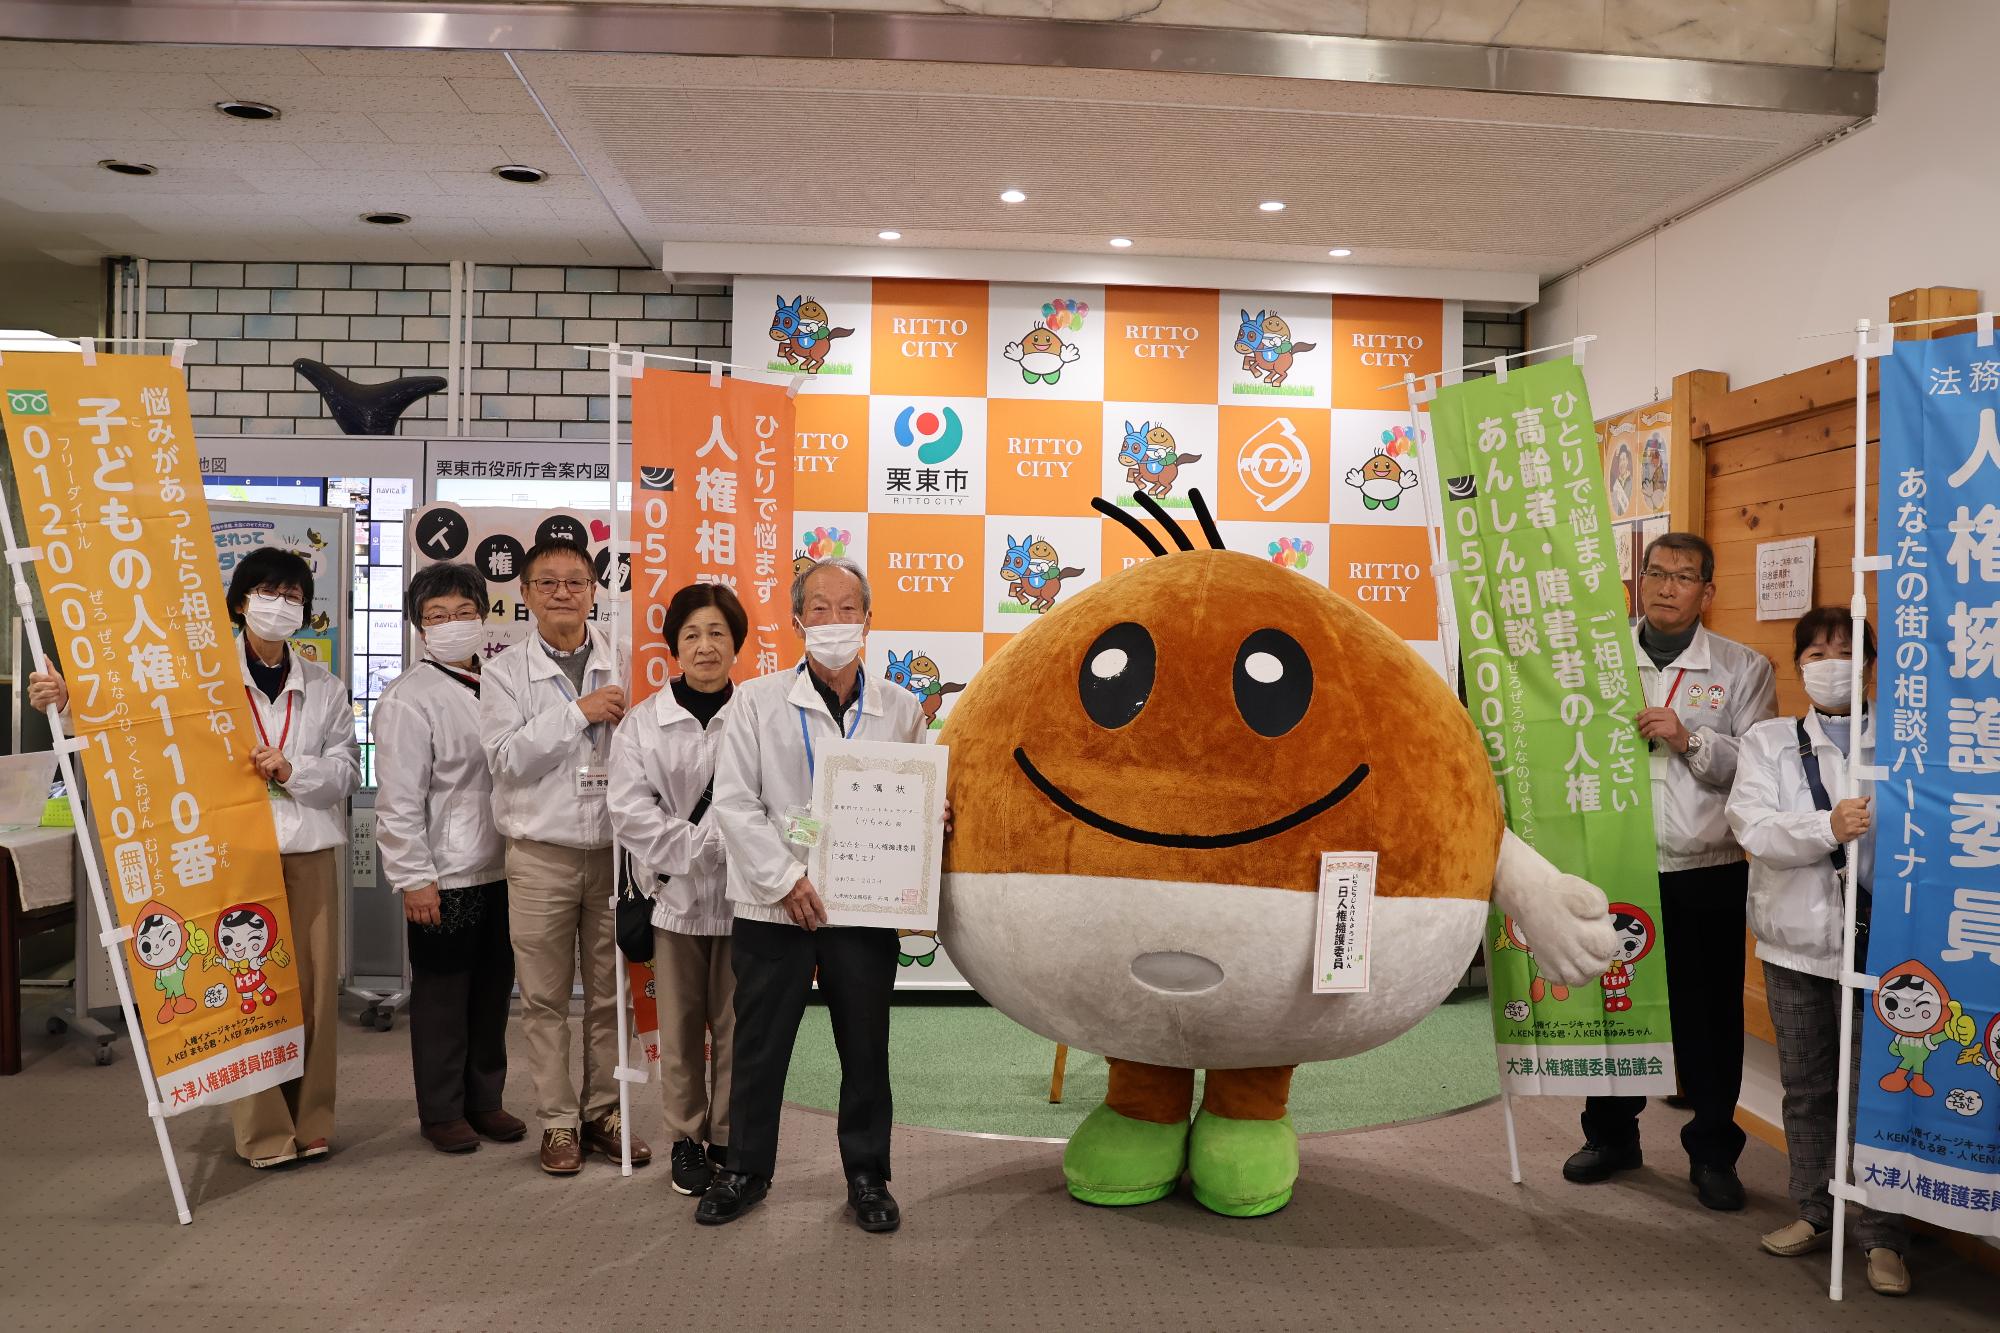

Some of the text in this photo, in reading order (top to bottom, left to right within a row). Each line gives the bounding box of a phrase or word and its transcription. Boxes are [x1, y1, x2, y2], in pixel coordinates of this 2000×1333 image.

[892, 317, 968, 337] RITTO
[1124, 324, 1199, 341] RITTO
[901, 340, 959, 358] CITY
[1134, 343, 1191, 359] CITY
[1351, 333, 1424, 350] RITTO
[1360, 352, 1415, 368] CITY
[795, 432, 849, 450] TTO
[1008, 437, 1082, 457] RITTO
[436, 460, 609, 479] 栗東市役所庁舎案内図
[1016, 460, 1074, 478] CITY
[886, 467, 968, 493] 栗東市
[57, 437, 92, 551] フリーダイヤル
[893, 497, 964, 506] RITTO CITY
[753, 414, 779, 605] ひとりで悩まず
[1478, 417, 1541, 657] あんしん相談
[488, 551, 513, 576] 権
[888, 552, 964, 571] RITTO
[1349, 562, 1420, 581] RITTO
[140, 387, 235, 763] 悩みがあったら相談してね！
[897, 575, 955, 594] CITY
[1357, 585, 1412, 603] CITY
[1551, 391, 1639, 812] ひとりで悩まず ご相談ください
[1511, 407, 1602, 813] 高齢者・障害者の人権
[78, 397, 217, 888] 子どもの人権110番
[1893, 467, 1928, 914] あなたの街の相談パートナー
[1506, 661, 1536, 845] ぜろぜろみんなのひゃくと
[119, 848, 148, 898] 無料
[1333, 878, 1350, 970] 一日人権擁護委員
[236, 971, 260, 988] KEN
[1603, 975, 1626, 987] KEN
[1532, 1020, 1624, 1029] 人権イメージキャラクター
[170, 1041, 299, 1107] 大津人権擁護委員協議会
[1506, 1056, 1663, 1077] 大津人権擁護委員協議会
